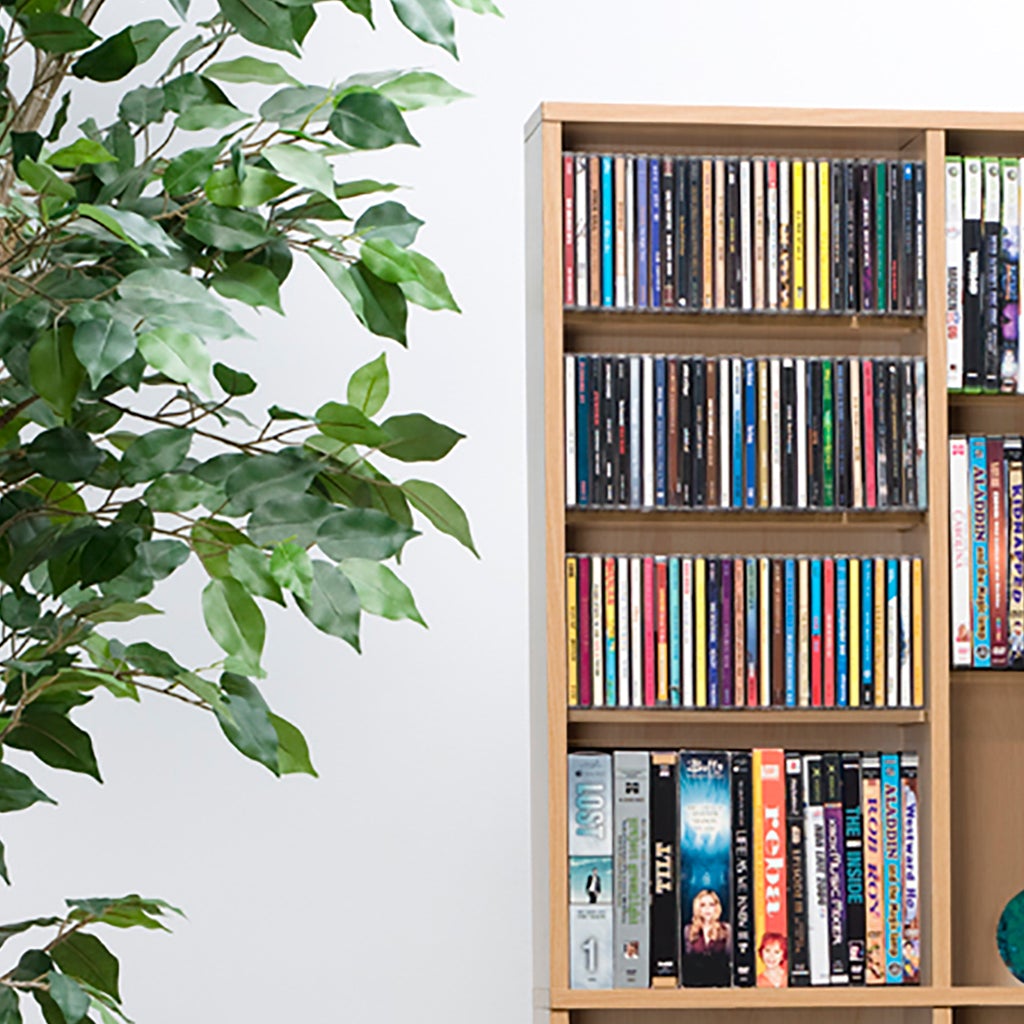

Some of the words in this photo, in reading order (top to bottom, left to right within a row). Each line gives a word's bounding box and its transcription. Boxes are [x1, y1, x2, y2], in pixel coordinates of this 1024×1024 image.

[973, 466, 986, 542] ALADDIN
[1012, 484, 1023, 603] KIDNAPPED
[575, 783, 605, 840] LOST
[845, 806, 860, 836] THE
[885, 784, 899, 859] ALADDIN
[655, 842, 672, 894] TILT
[764, 806, 784, 918] reba
[905, 803, 916, 881] Westward
[847, 851, 863, 904] INSIDE
[868, 863, 879, 917] ROY
[906, 888, 916, 909] Ho
[582, 937, 597, 973] 1
